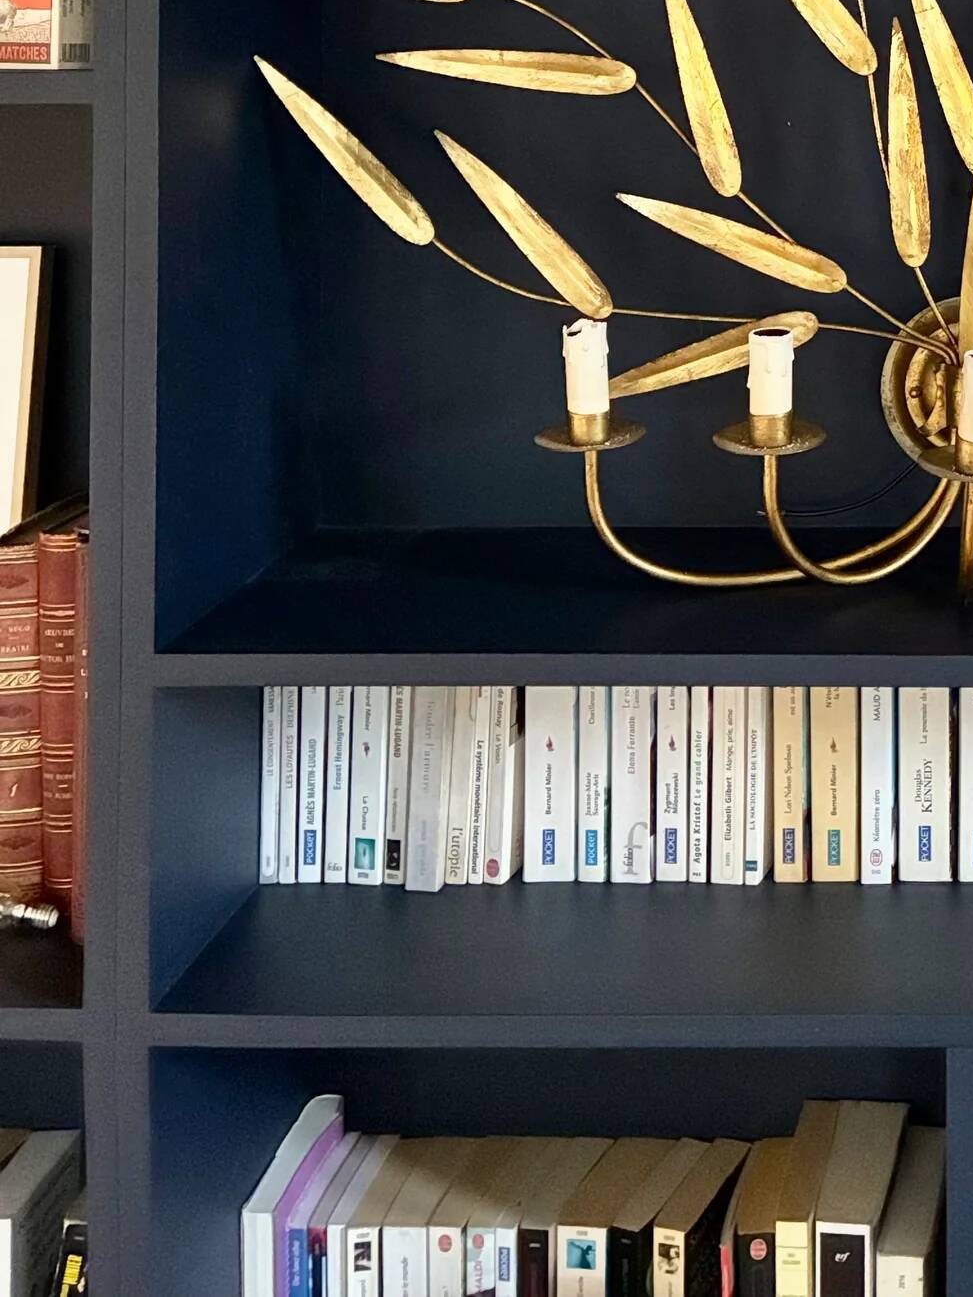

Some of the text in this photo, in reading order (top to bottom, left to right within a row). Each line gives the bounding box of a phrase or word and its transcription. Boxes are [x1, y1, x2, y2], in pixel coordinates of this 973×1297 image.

[872, 694, 881, 722] MAUD
[334, 715, 345, 763] Hemingway
[694, 730, 703, 758] cahier
[305, 738, 317, 825] AGNÈS MARTIN-LUGAND
[694, 761, 704, 786] grand
[914, 769, 923, 803] Douglas
[921, 757, 933, 813] KENNEDY
[469, 739, 485, 875] Le système monétaire international
[724, 777, 732, 804] Gilbert
[749, 774, 757, 820] SOCIOLOGIE
[830, 788, 838, 816] Bernard
[692, 803, 702, 835] Kristof
[724, 806, 732, 842] Elizabeth
[304, 831, 316, 864] POCKET
[449, 827, 464, 878] l'utopie
[587, 832, 596, 864] POCKET
[665, 830, 677, 864] POCKET
[692, 838, 703, 865] Agota
[783, 830, 795, 863] POCKET
[919, 827, 930, 861] POCKET
